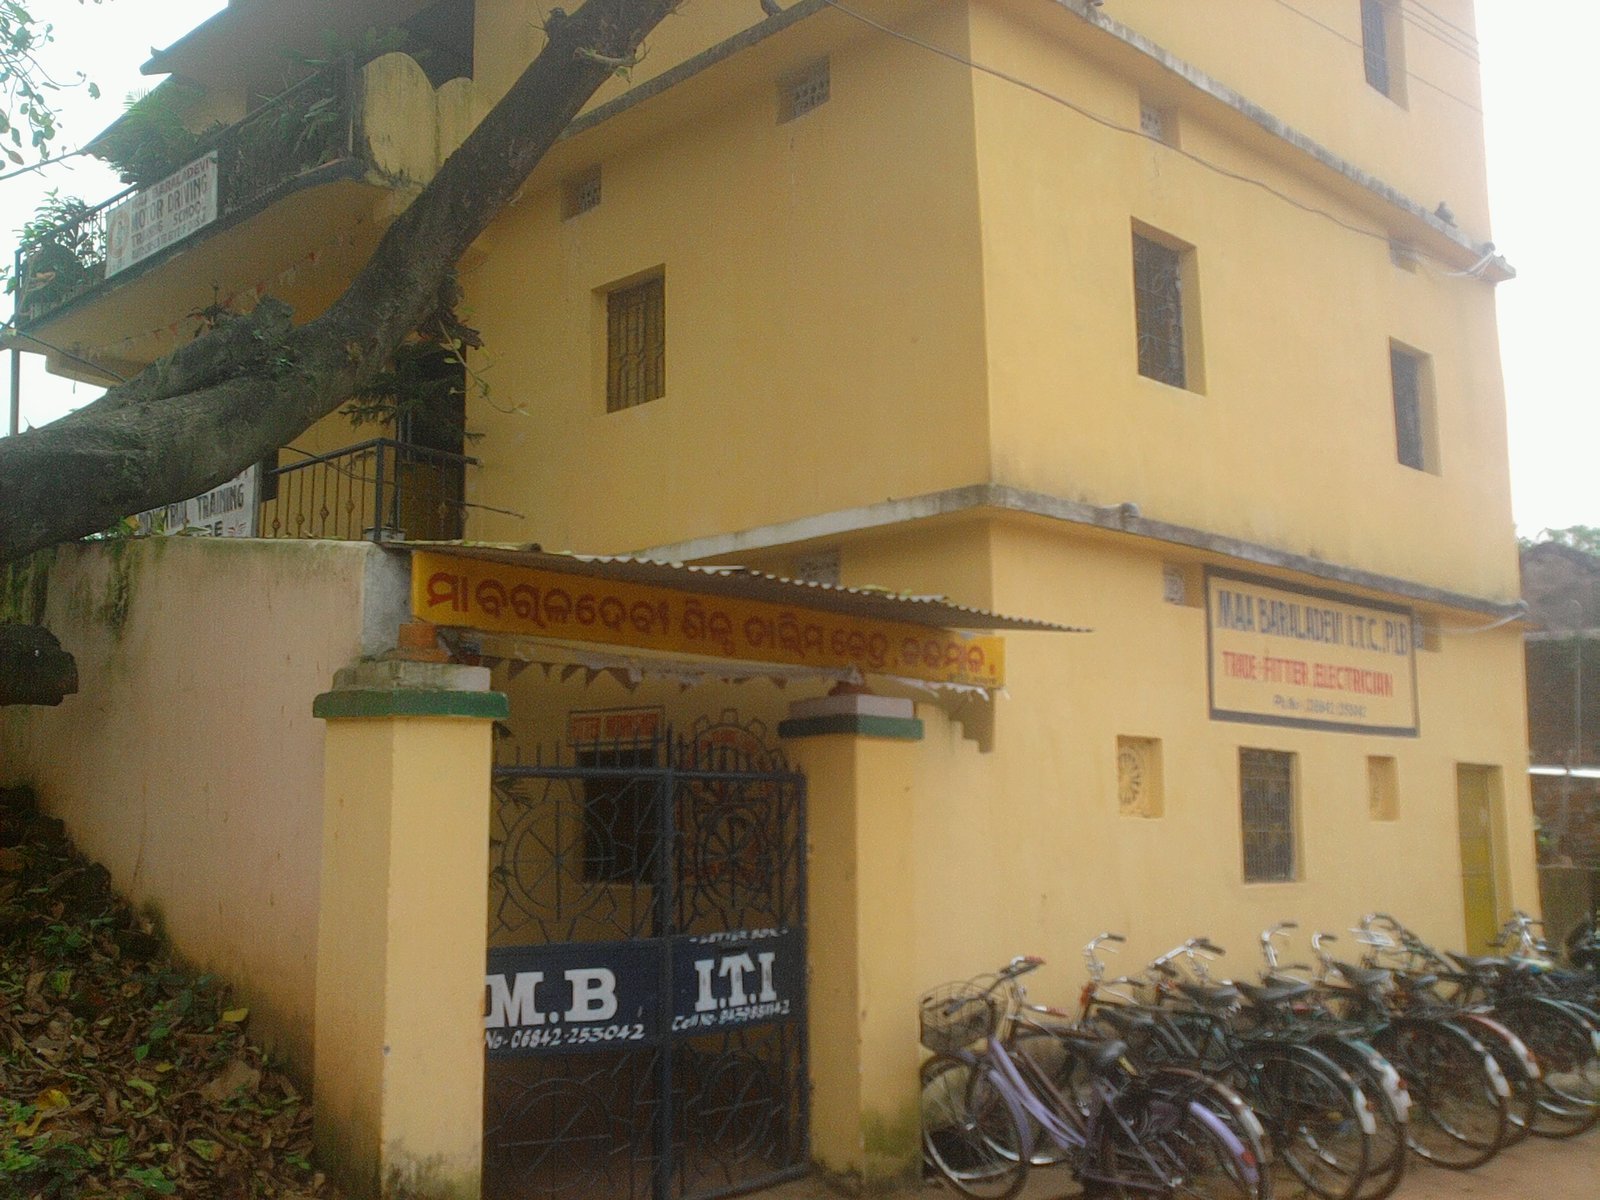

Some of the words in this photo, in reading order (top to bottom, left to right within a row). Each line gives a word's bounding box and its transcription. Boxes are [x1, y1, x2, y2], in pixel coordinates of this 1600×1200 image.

[131, 199, 164, 233] MOTOR
[167, 173, 208, 212] DRIVING
[197, 483, 245, 519] TRAINING
[1218, 590, 1256, 632] MAA
